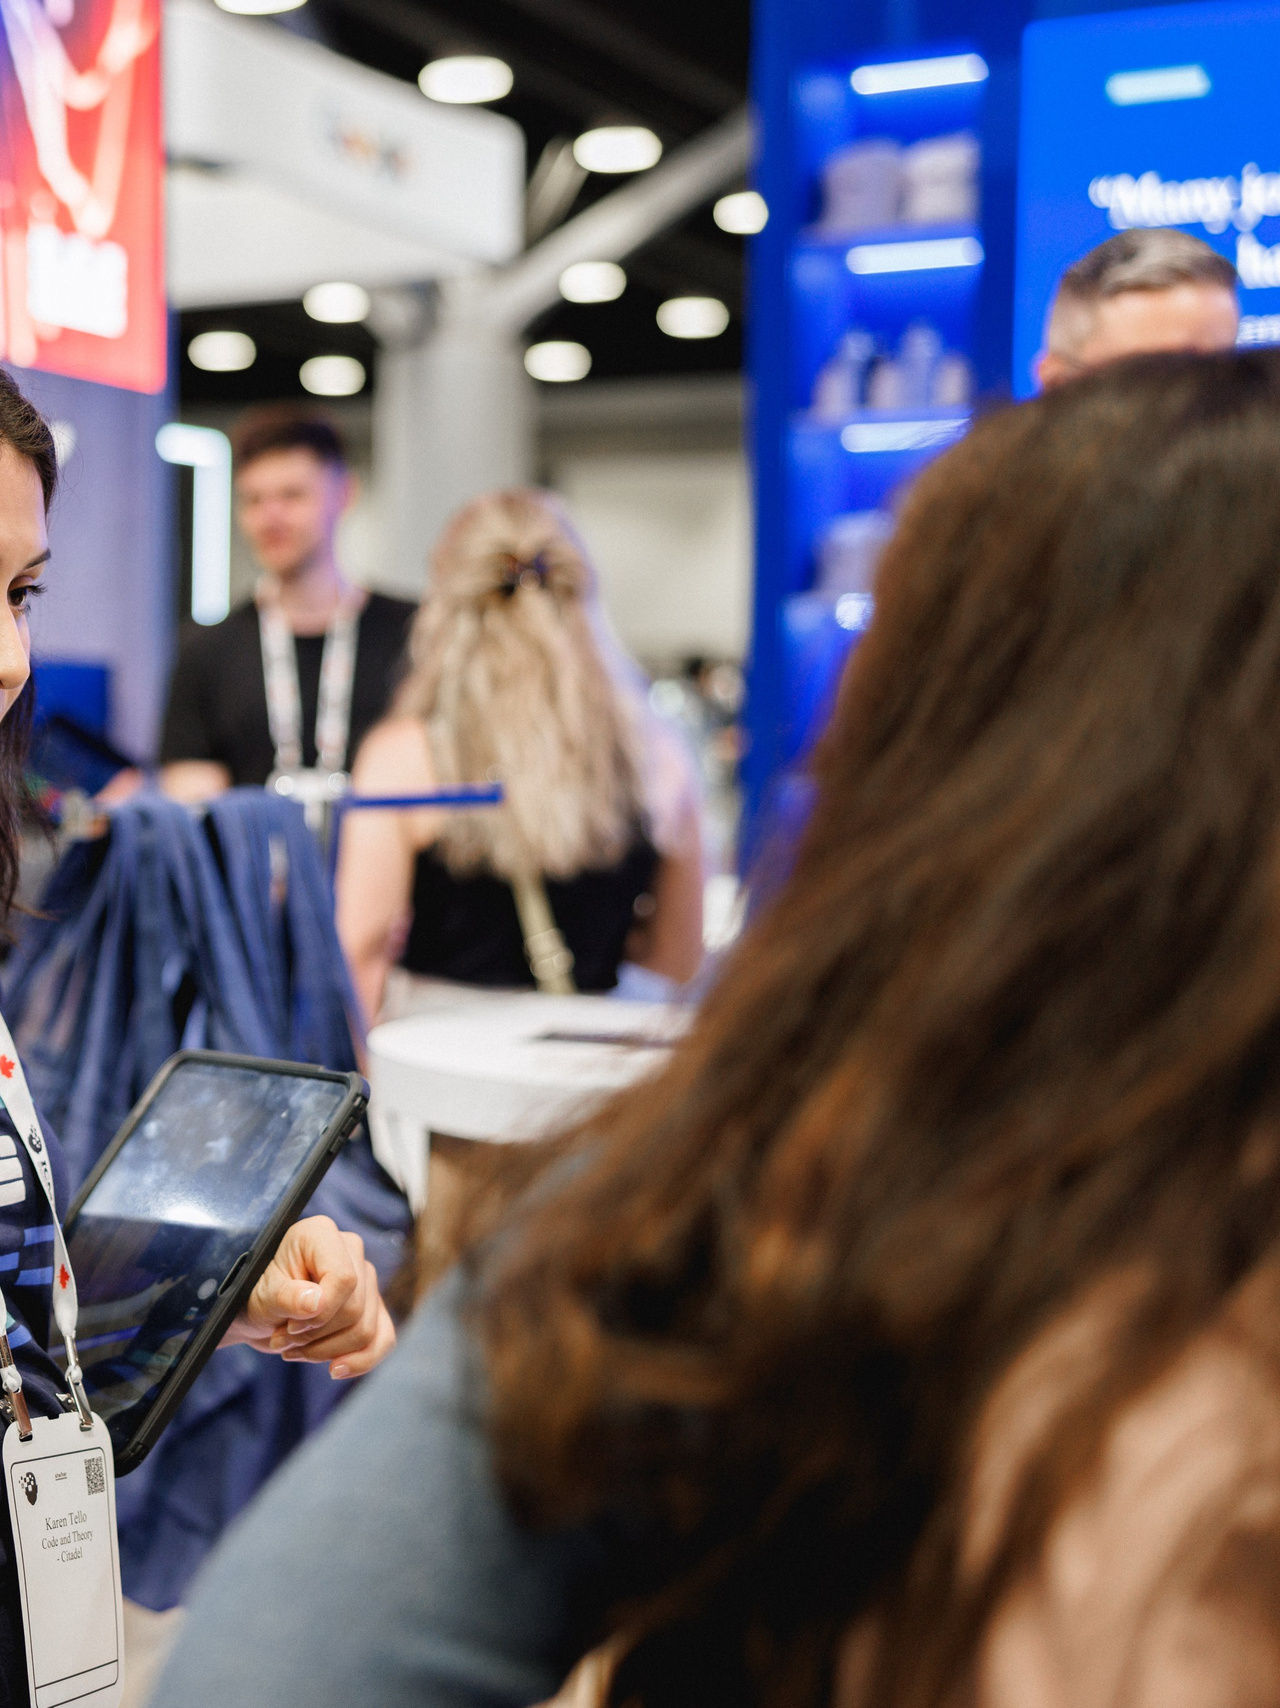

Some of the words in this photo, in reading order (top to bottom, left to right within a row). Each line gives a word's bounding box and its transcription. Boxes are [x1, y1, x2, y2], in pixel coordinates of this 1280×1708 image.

[45, 1517, 68, 1530] Karen
[68, 1510, 87, 1525] Tello
[41, 1536, 59, 1549] Code
[59, 1532, 71, 1545] and
[72, 1530, 93, 1541] Theory
[61, 1546, 83, 1562] Citadel
